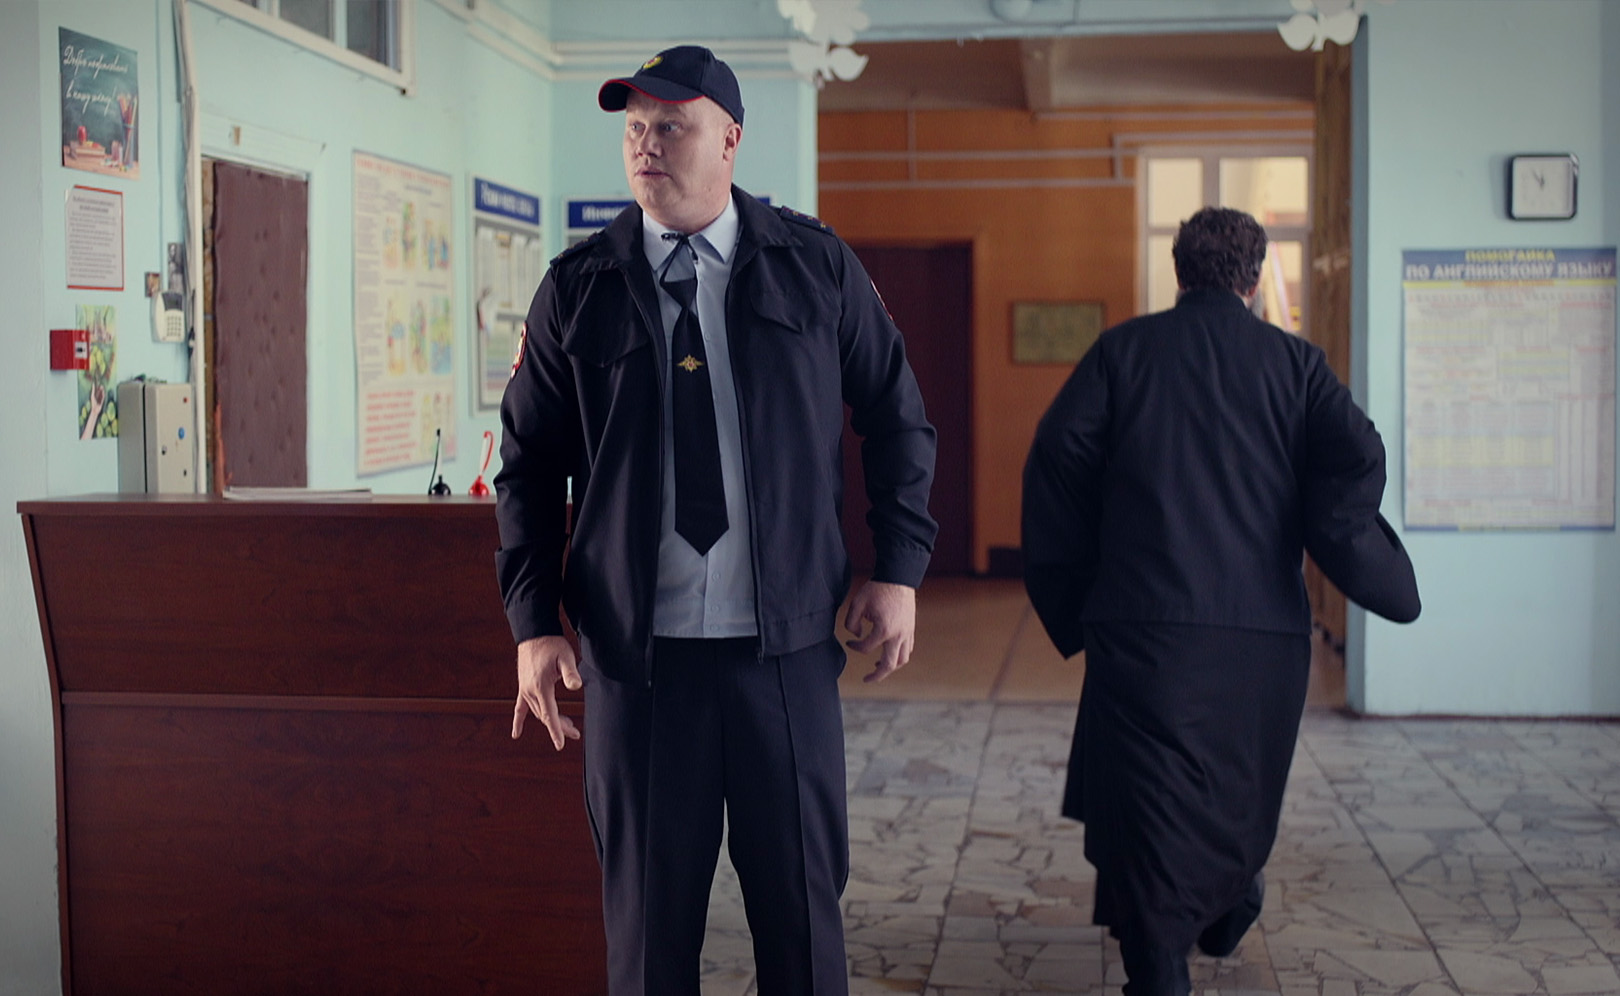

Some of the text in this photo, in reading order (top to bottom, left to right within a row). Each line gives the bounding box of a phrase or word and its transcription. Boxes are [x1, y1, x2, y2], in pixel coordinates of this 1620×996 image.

[1406, 262, 1612, 279] ПО АНГЛИЙСКОМУ ЯЗЫКУ
